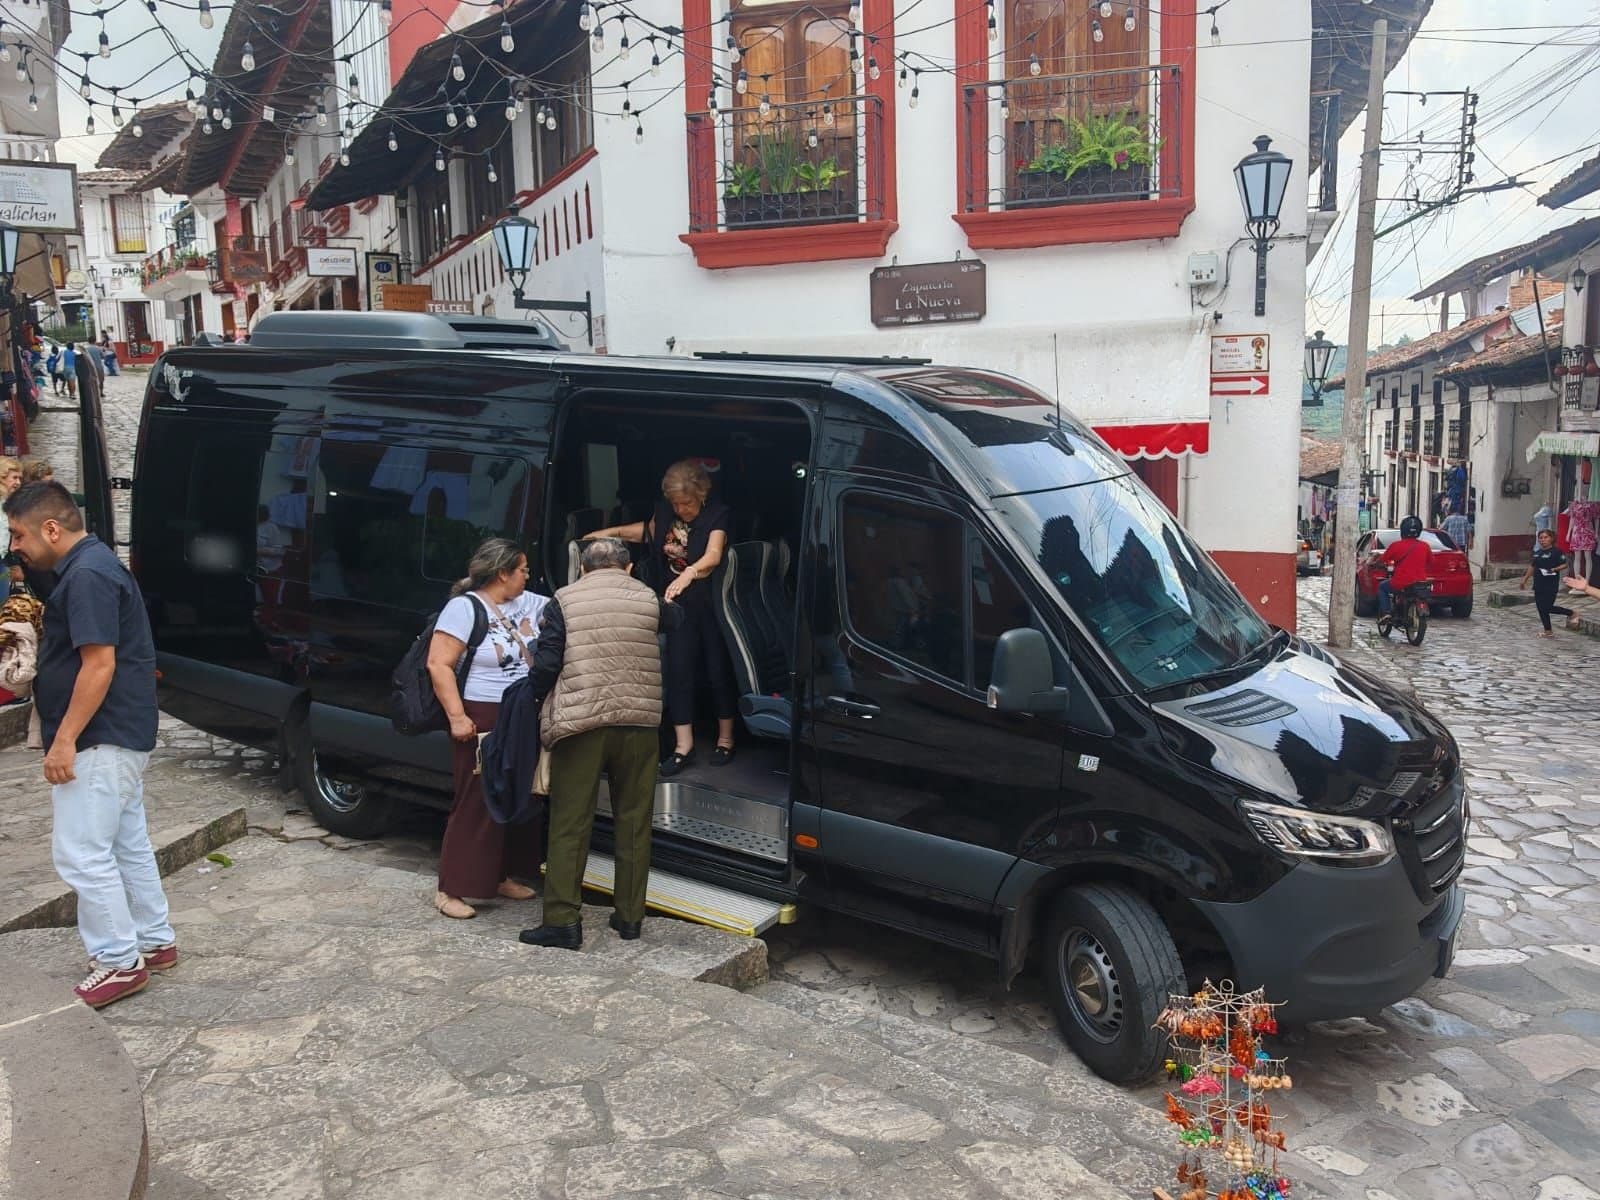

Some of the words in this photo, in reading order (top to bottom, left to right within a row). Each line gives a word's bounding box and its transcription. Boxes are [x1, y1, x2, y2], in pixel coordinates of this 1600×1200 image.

[427, 303, 471, 313] TELCEL
[895, 298, 912, 310] La
[917, 295, 961, 308] Nueva
